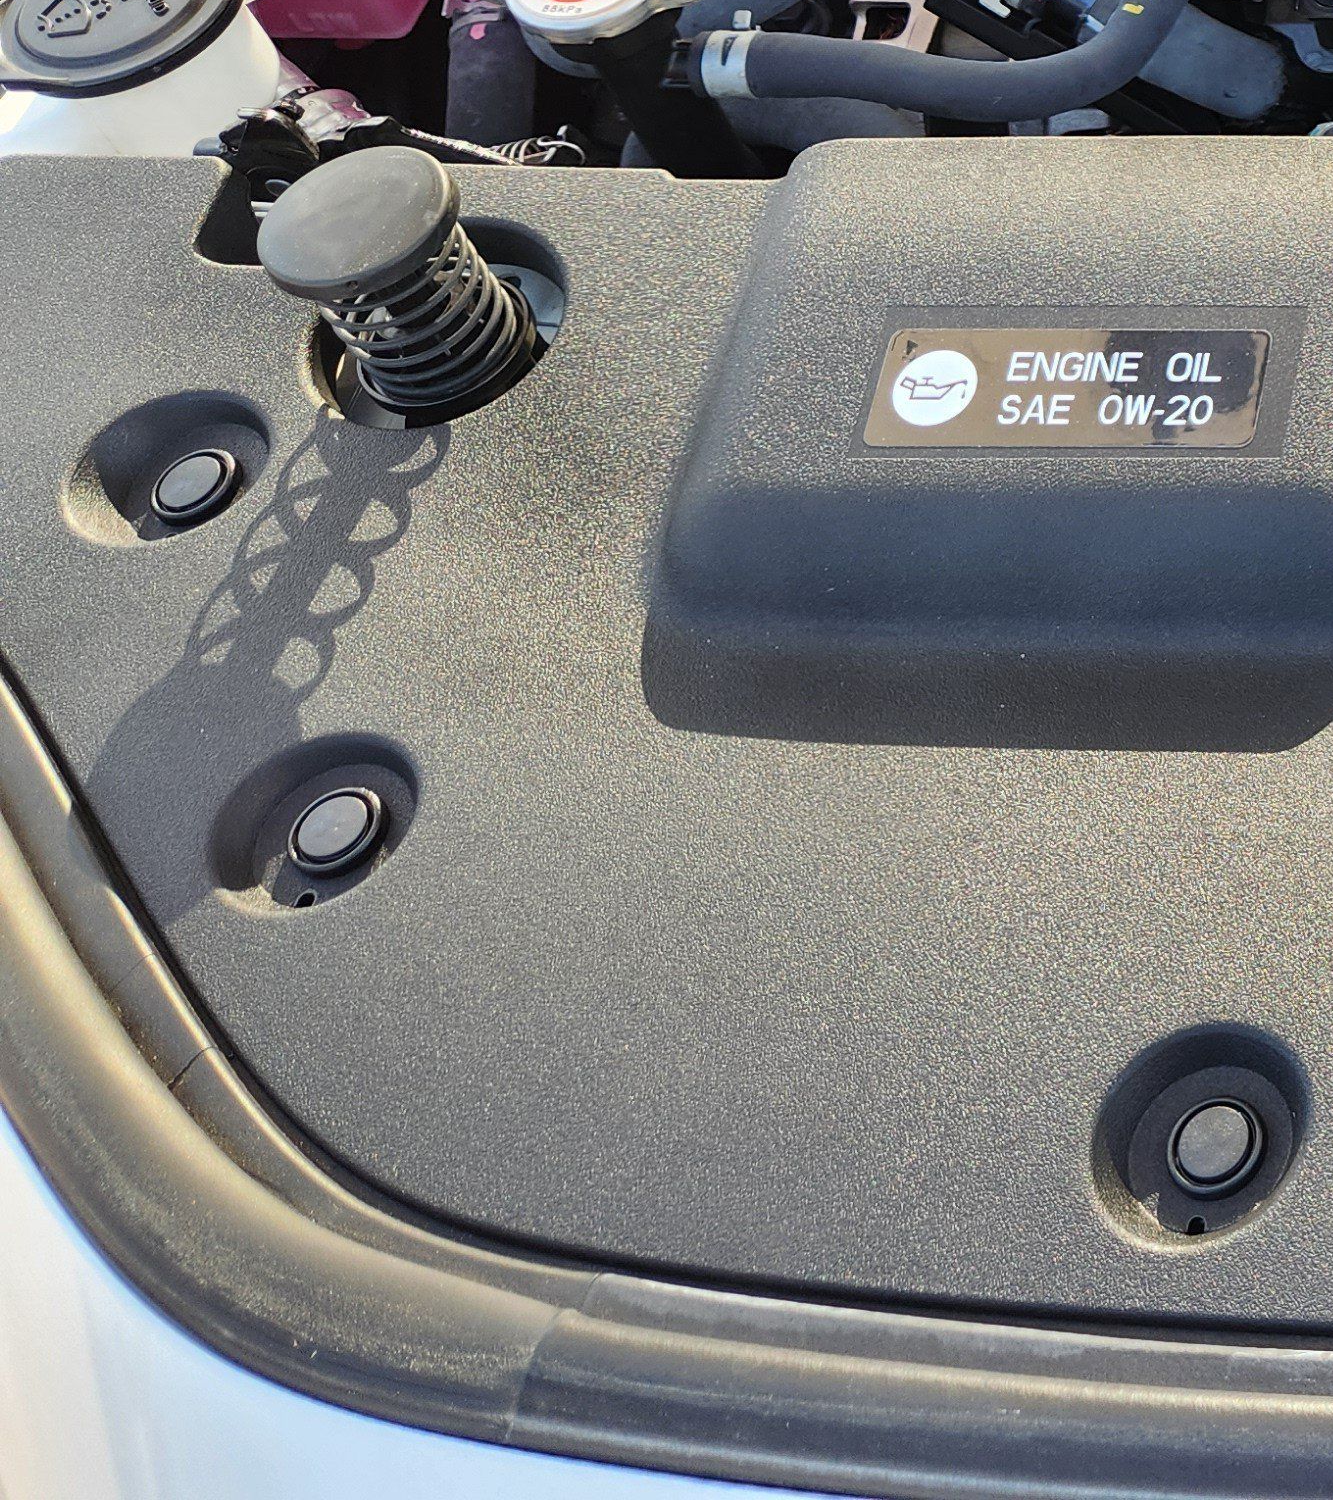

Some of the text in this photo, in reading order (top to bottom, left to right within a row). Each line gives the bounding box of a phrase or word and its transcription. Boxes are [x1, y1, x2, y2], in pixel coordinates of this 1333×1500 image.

[1005, 350, 1222, 383] ENGINE OIL
[997, 394, 1215, 426] SAE 0W-20
